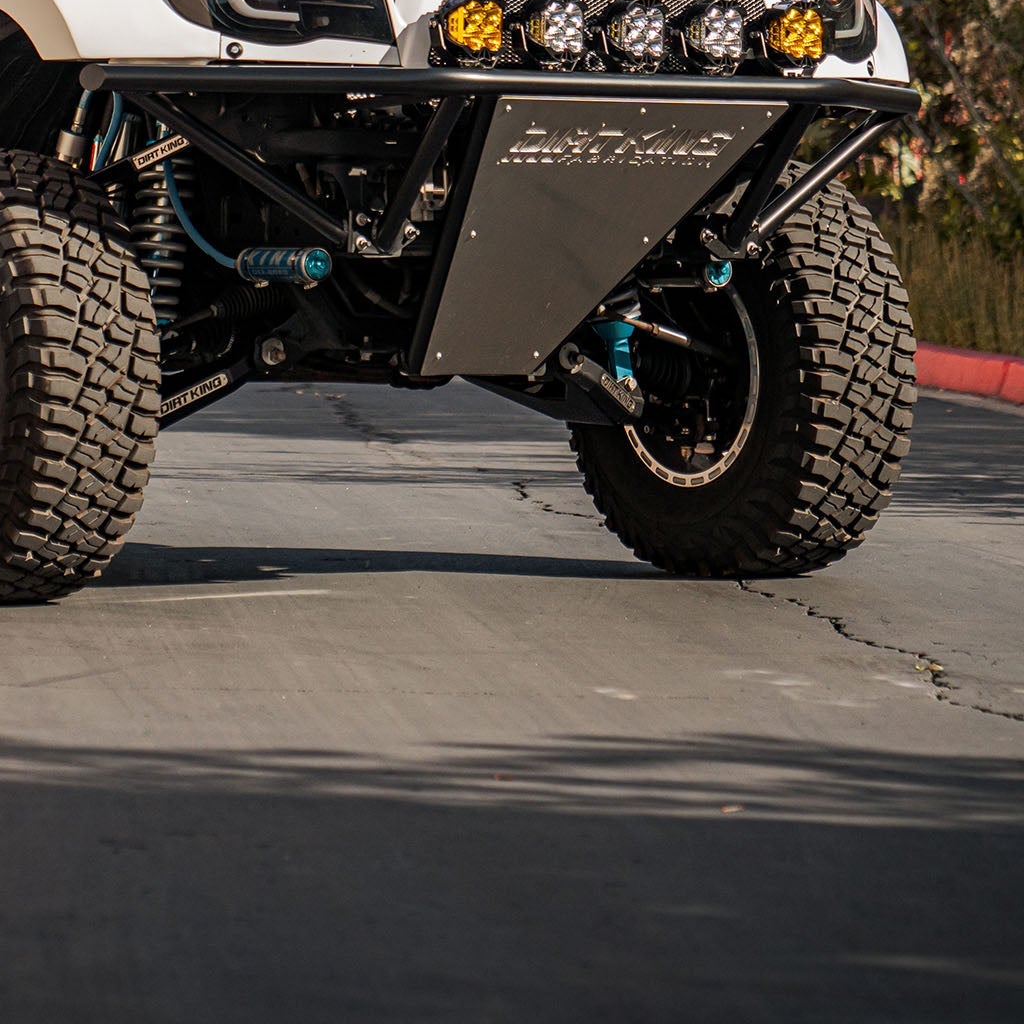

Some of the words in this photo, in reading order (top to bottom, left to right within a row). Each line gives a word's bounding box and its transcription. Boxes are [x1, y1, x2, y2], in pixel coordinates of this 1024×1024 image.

[137, 148, 160, 166] DIRT
[160, 137, 185, 155] KING
[509, 127, 627, 154] DIRT
[160, 392, 188, 415] DIRT
[189, 376, 222, 400] KING
